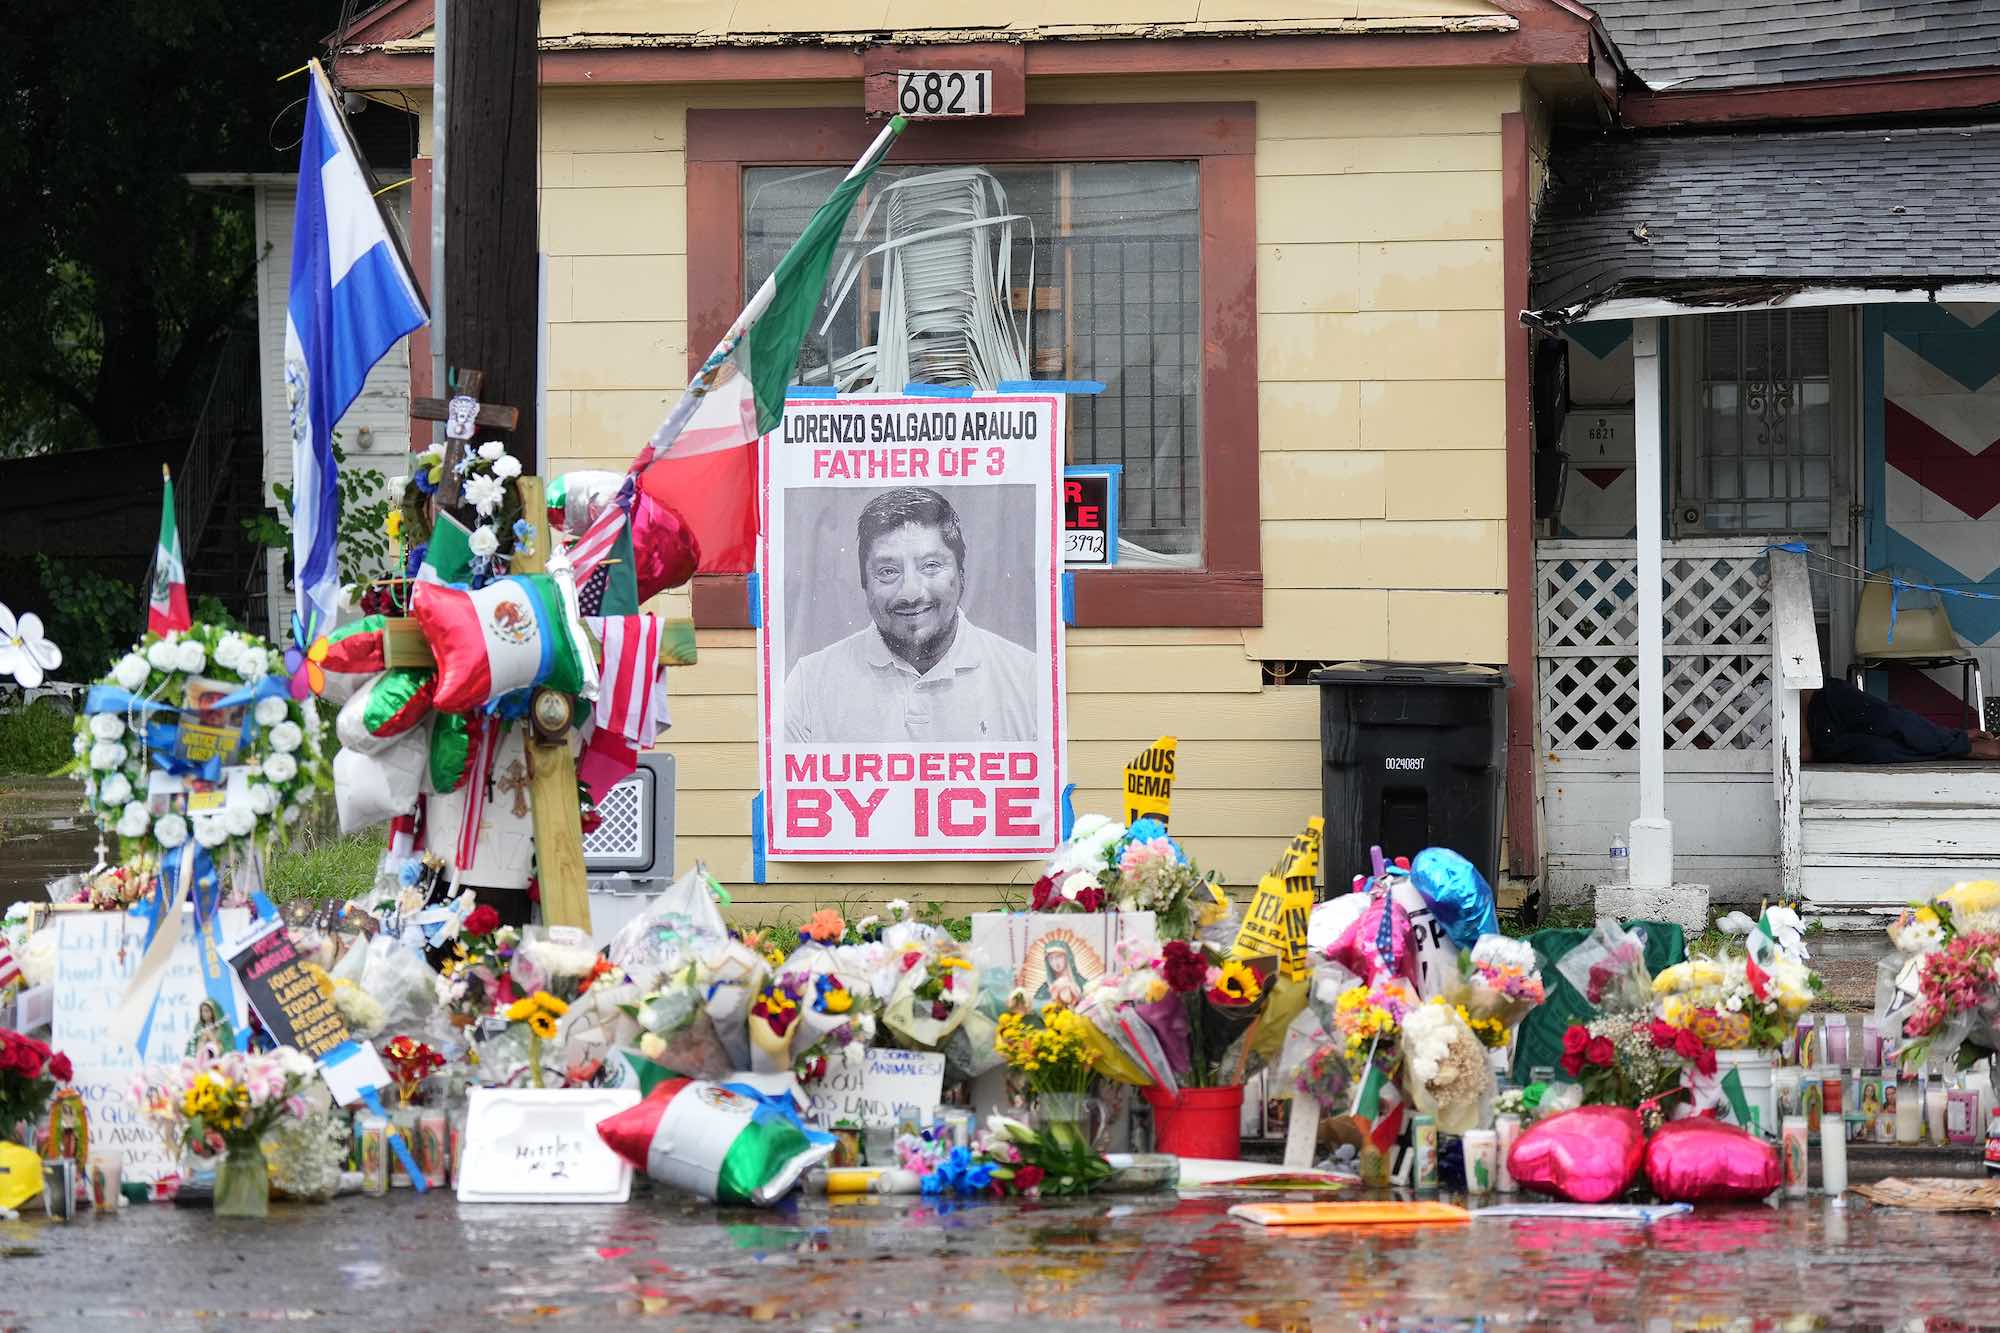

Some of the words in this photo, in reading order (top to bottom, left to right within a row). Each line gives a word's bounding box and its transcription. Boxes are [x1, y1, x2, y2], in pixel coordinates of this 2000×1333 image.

[901, 72, 985, 114] 6821
[783, 414, 866, 444] LORENZO
[871, 412, 957, 443] SALGADO
[961, 411, 1037, 441] ARAUJO
[813, 448, 929, 479] FATHER
[938, 447, 978, 477] OF
[986, 447, 1005, 476] 3
[785, 752, 1038, 783] MURDERED
[1385, 757, 1425, 770] 00240897
[1128, 773, 1171, 799] DEMA
[786, 788, 890, 838] BY
[914, 787, 1040, 838] ICE
